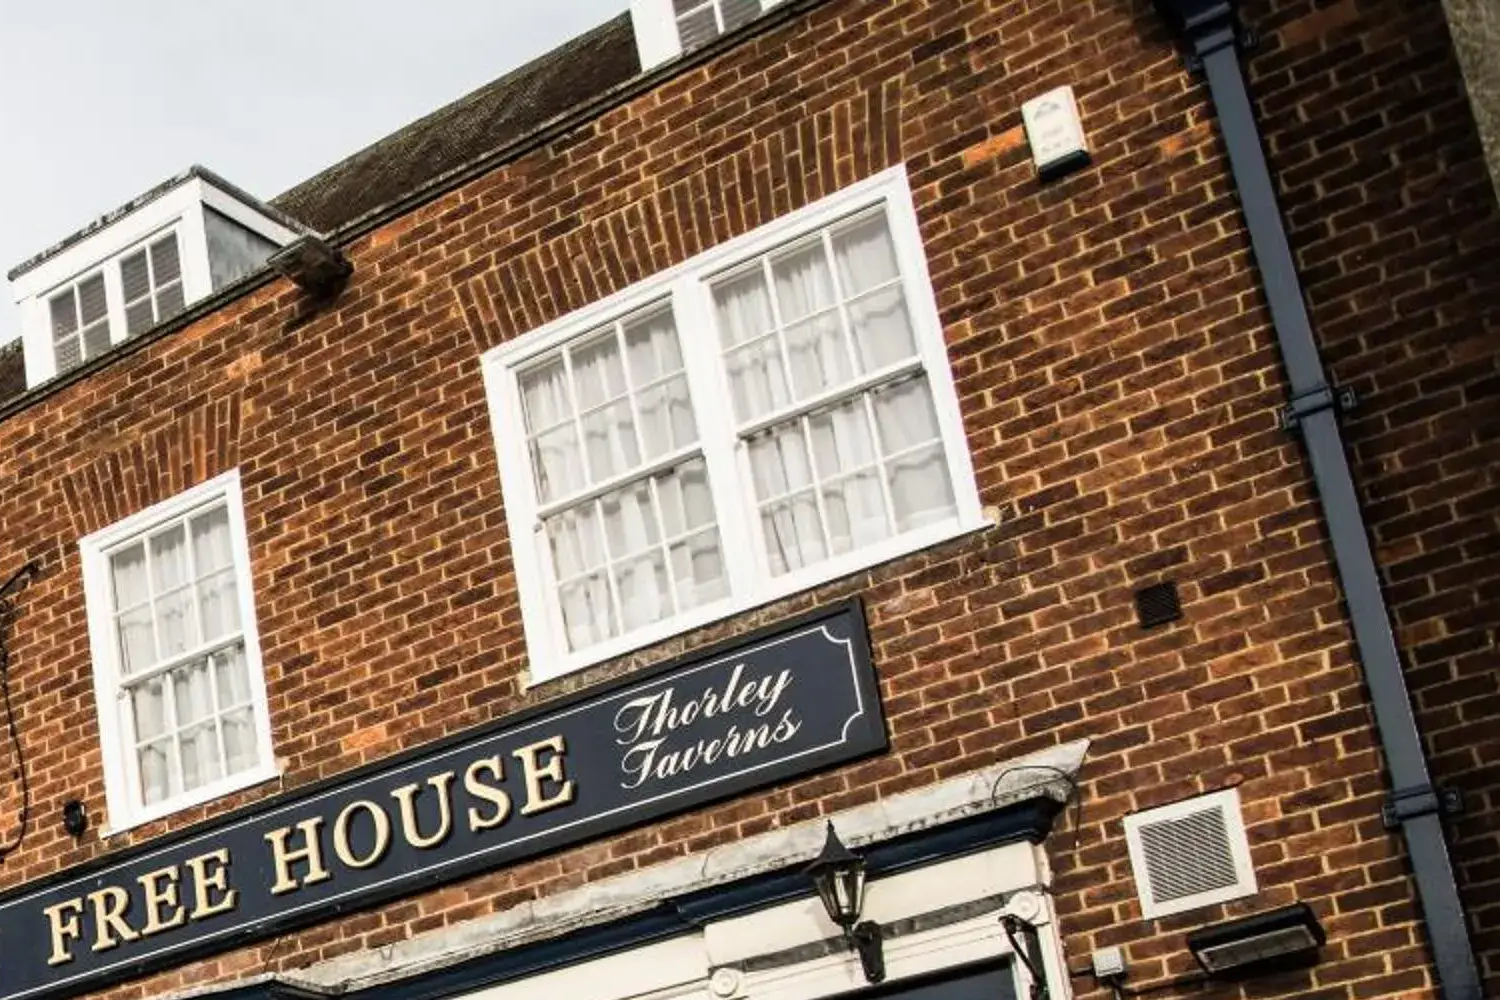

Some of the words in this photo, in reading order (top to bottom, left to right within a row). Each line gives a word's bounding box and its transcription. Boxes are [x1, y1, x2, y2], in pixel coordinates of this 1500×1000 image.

[613, 663, 793, 745] Thorley
[620, 707, 802, 789] Taverns
[43, 847, 237, 966] FREE
[263, 734, 576, 895] HOUSE
